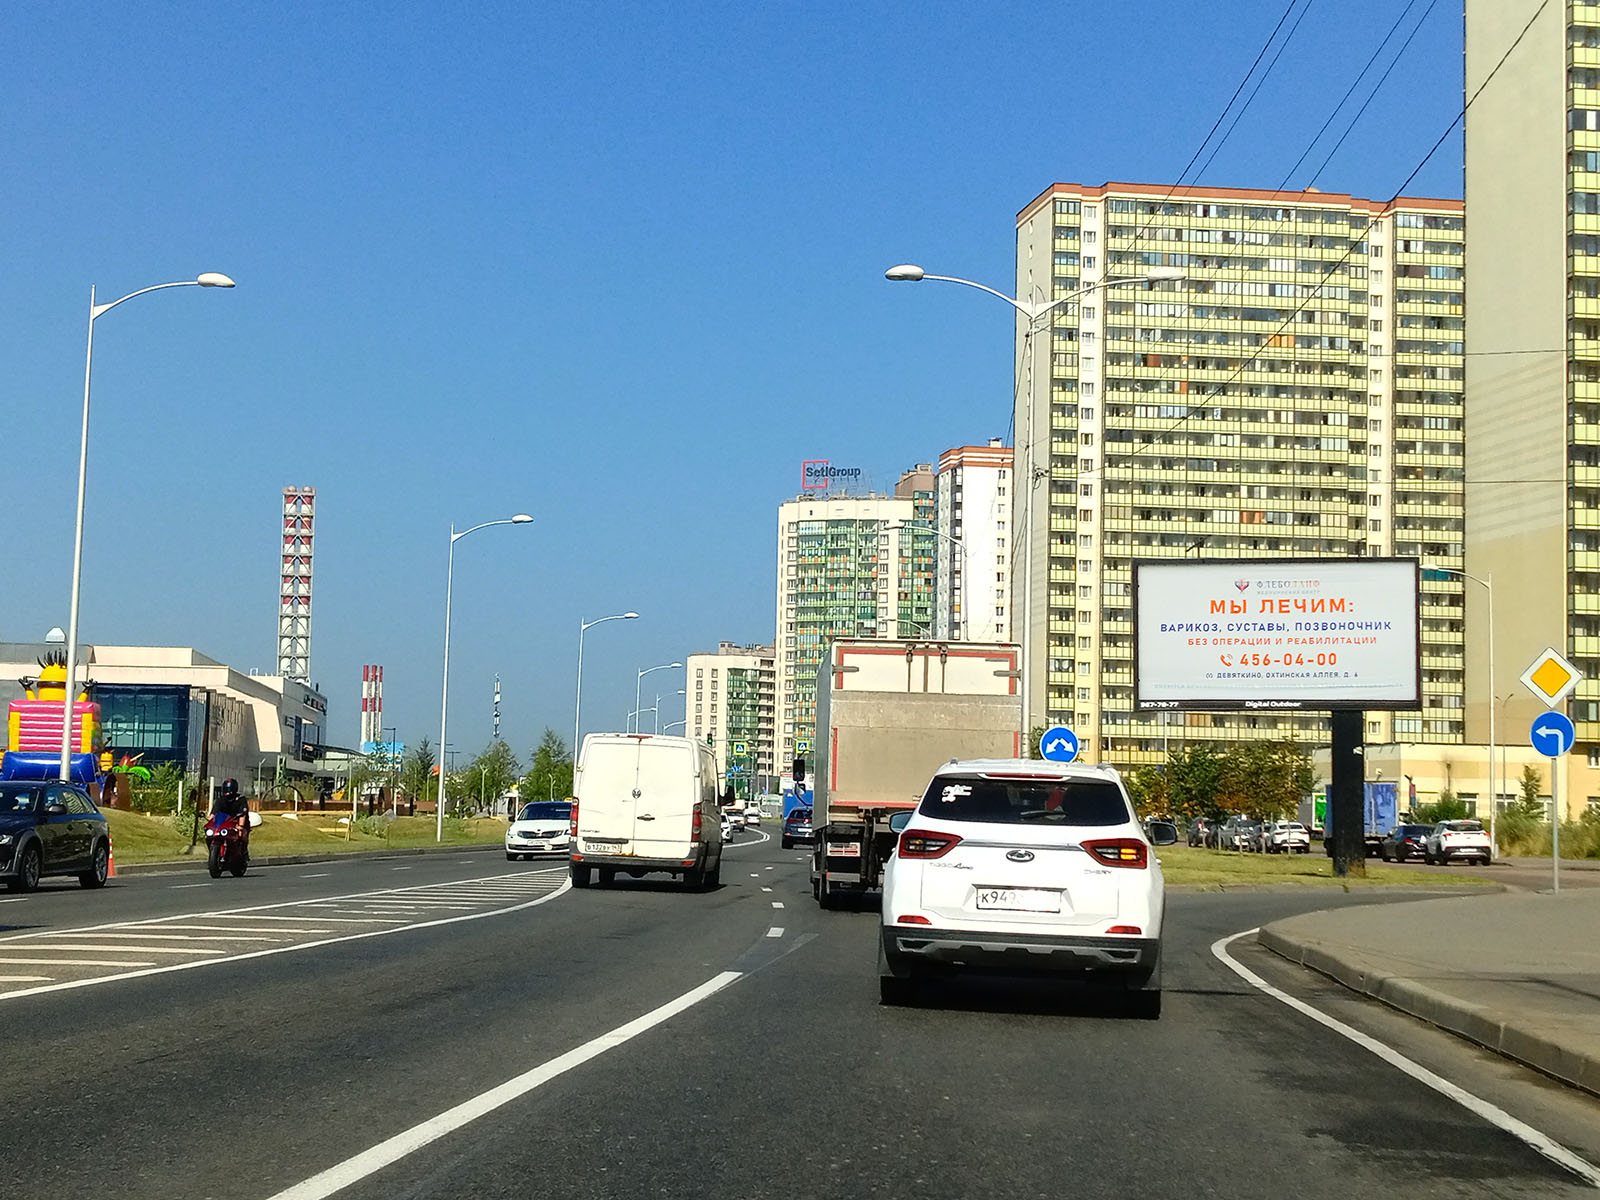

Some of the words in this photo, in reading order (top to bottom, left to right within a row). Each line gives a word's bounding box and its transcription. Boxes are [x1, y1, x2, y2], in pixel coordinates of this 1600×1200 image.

[1210, 599, 1247, 614] МЫ
[1259, 598, 1354, 614] ЛЕЧИМ:
[1160, 623, 1222, 633] ВАРИКОЗ,
[1227, 622, 1290, 632] СУСТАВЫ,
[1295, 621, 1392, 631] ПОЗВОНОЧНИК
[1188, 638, 1208, 646] БЕЗ
[1212, 637, 1271, 647] ОПЕРАЦИИ
[1287, 636, 1377, 645] РЕАБИЛИТАЦИИ
[1240, 653, 1337, 666] 456-04-00
